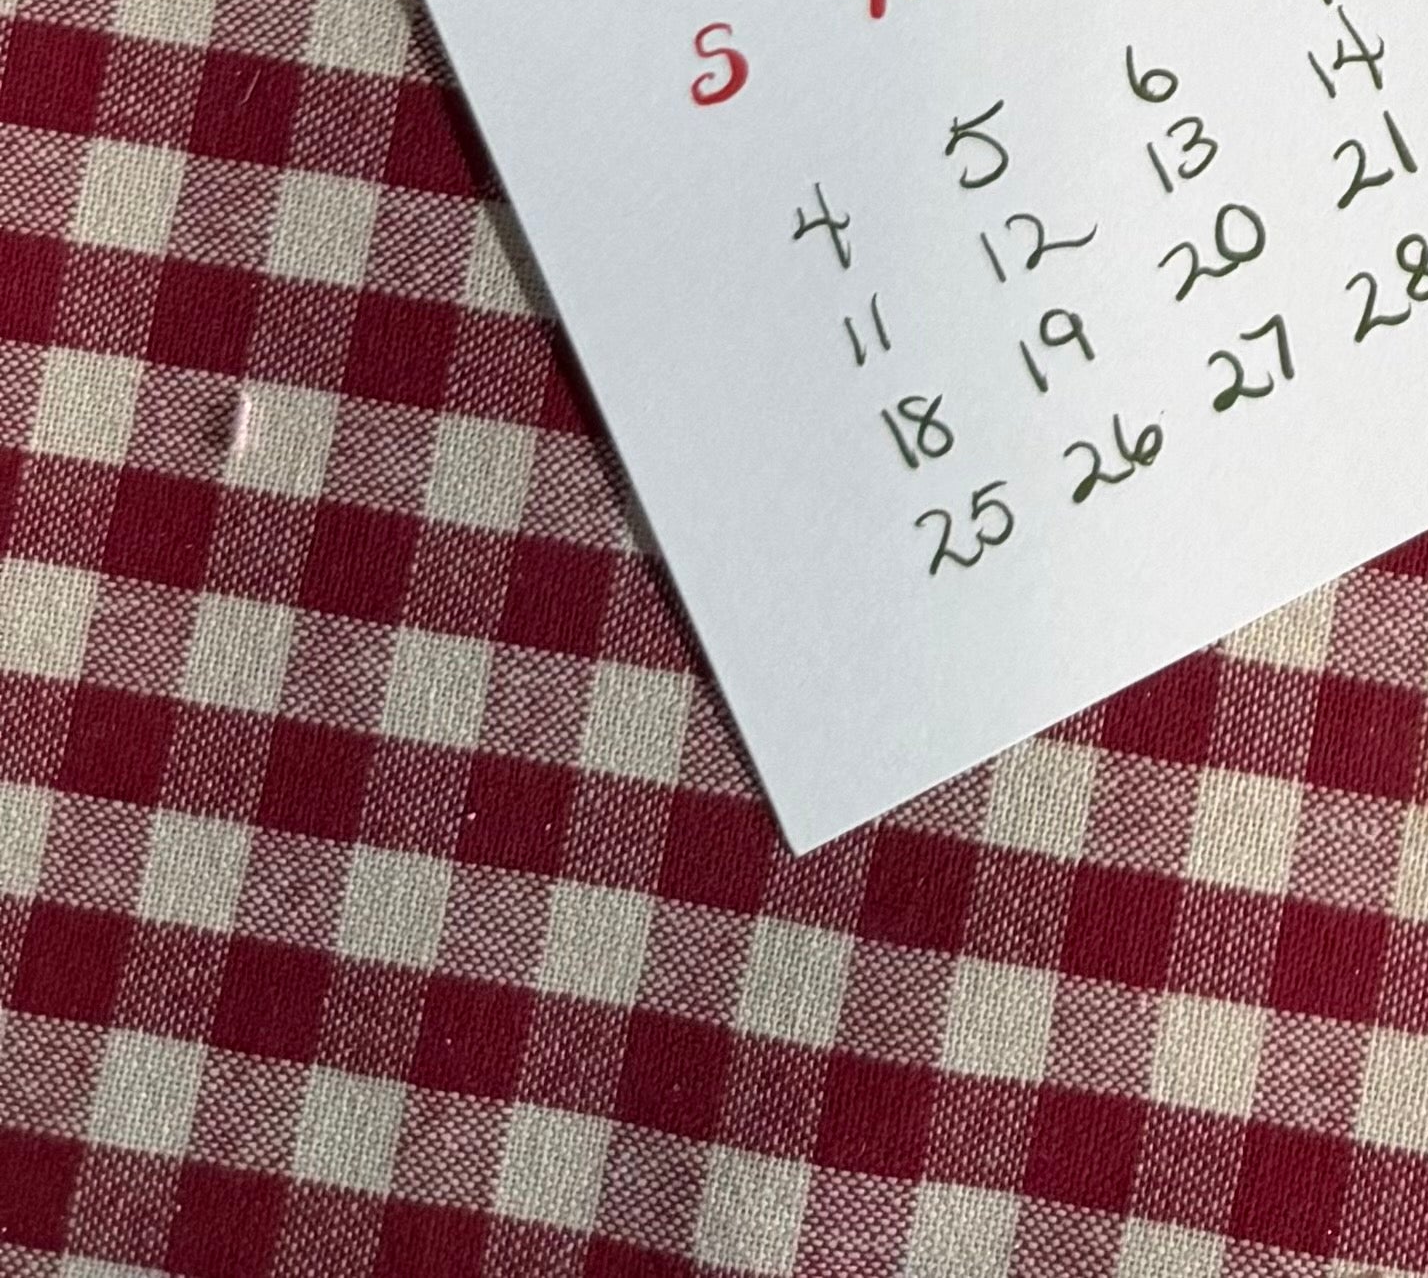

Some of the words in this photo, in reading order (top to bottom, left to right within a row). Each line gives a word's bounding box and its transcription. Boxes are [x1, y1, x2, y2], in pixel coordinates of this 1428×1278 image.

[689, 21, 750, 108] S
[791, 181, 852, 271] 4
[943, 98, 1010, 191] 5
[1125, 44, 1180, 104] 6
[842, 292, 892, 368] 11
[979, 212, 1098, 284] 12
[1145, 116, 1219, 195] 13
[1307, 4, 1385, 100] 14
[879, 393, 955, 472] 18
[1018, 308, 1096, 396] 19
[1156, 202, 1267, 303] 20
[1332, 110, 1419, 212] 21
[912, 479, 1015, 578] 25
[1062, 413, 1164, 506] 26
[1206, 313, 1296, 415] 27
